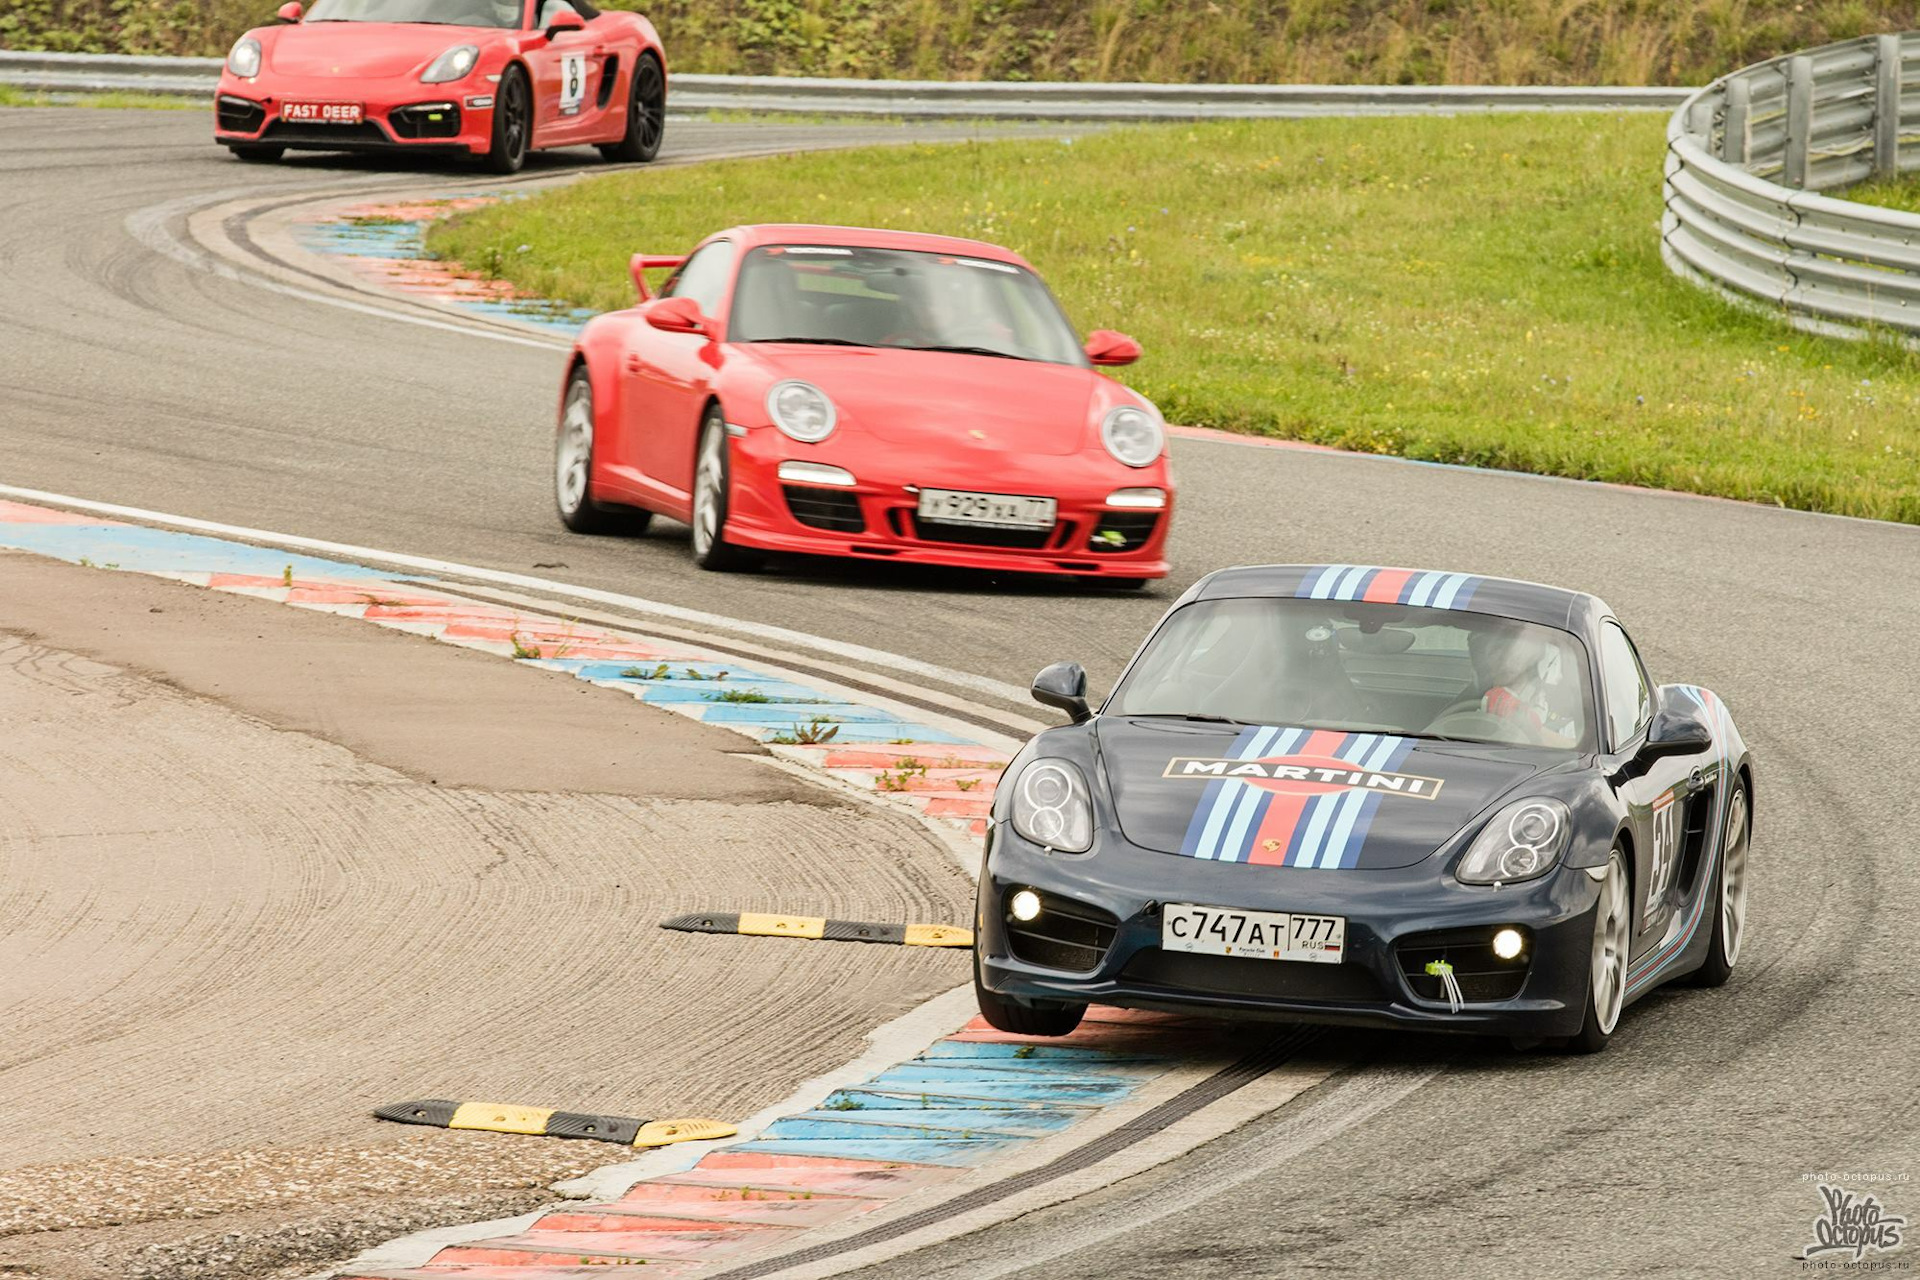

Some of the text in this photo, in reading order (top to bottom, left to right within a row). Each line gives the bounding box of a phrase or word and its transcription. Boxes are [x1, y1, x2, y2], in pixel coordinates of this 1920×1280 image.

[284, 104, 361, 118] FAST DEER
[1182, 761, 1425, 793] MARTINI
[1171, 911, 1336, 946] C747AT 777
[1302, 940, 1324, 950] RUS
